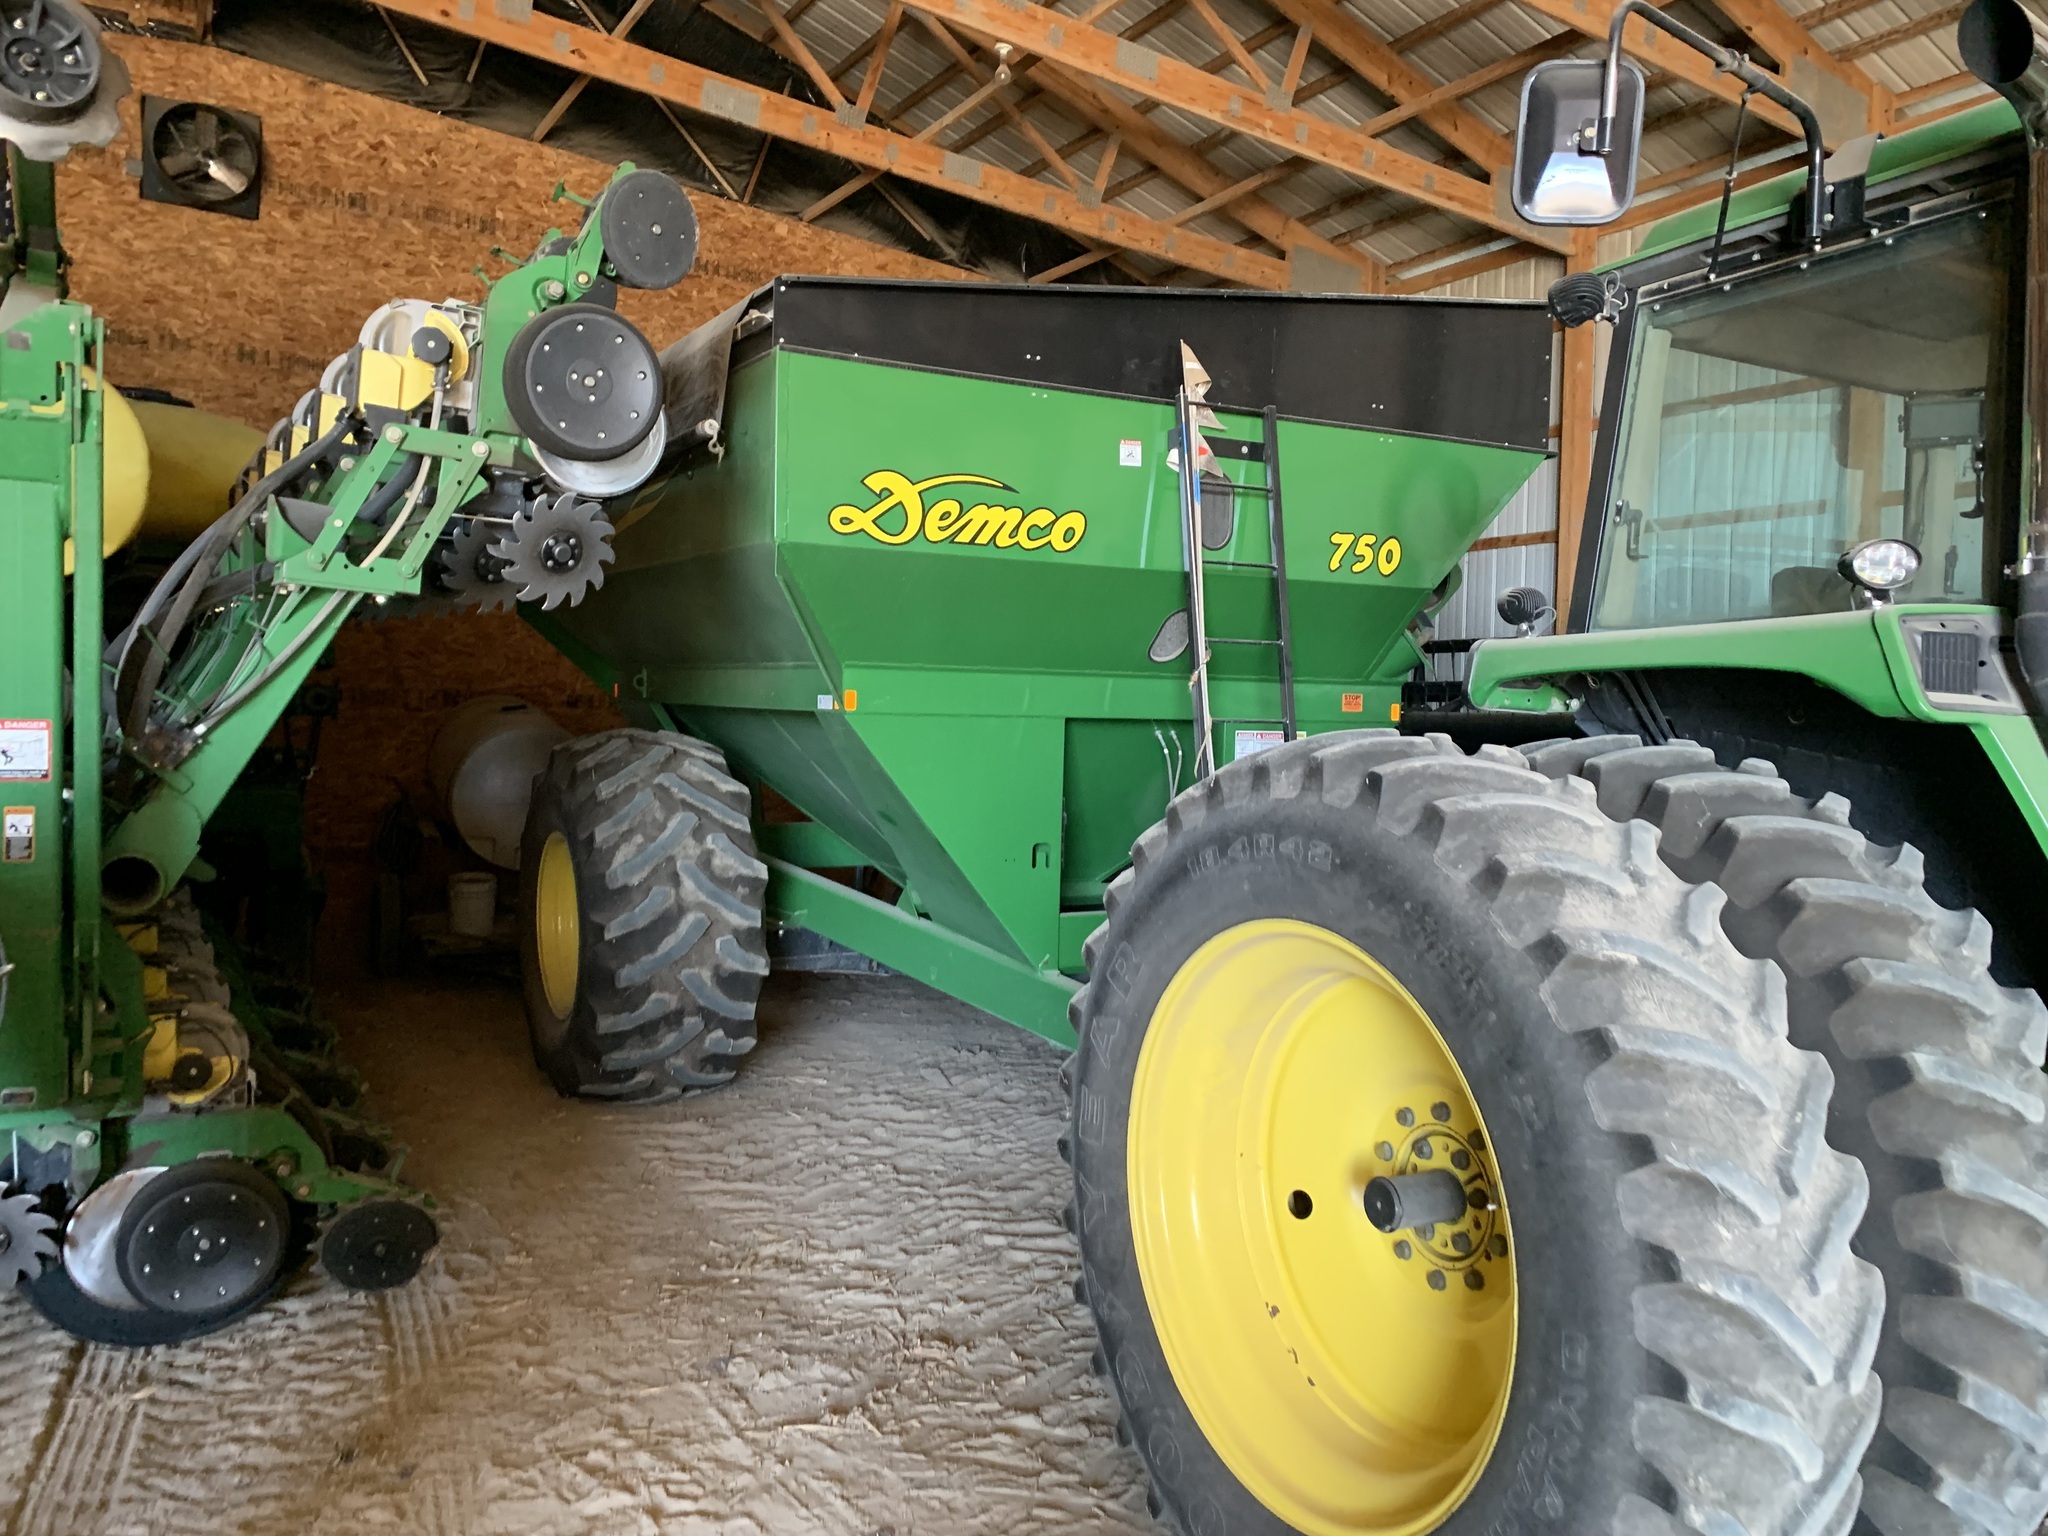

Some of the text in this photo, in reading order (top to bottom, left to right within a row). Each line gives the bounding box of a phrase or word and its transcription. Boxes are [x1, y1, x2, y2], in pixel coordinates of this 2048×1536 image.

[829, 469, 1087, 553] Demco
[1328, 532, 1403, 577] 750
[4, 721, 46, 729] DANGER
